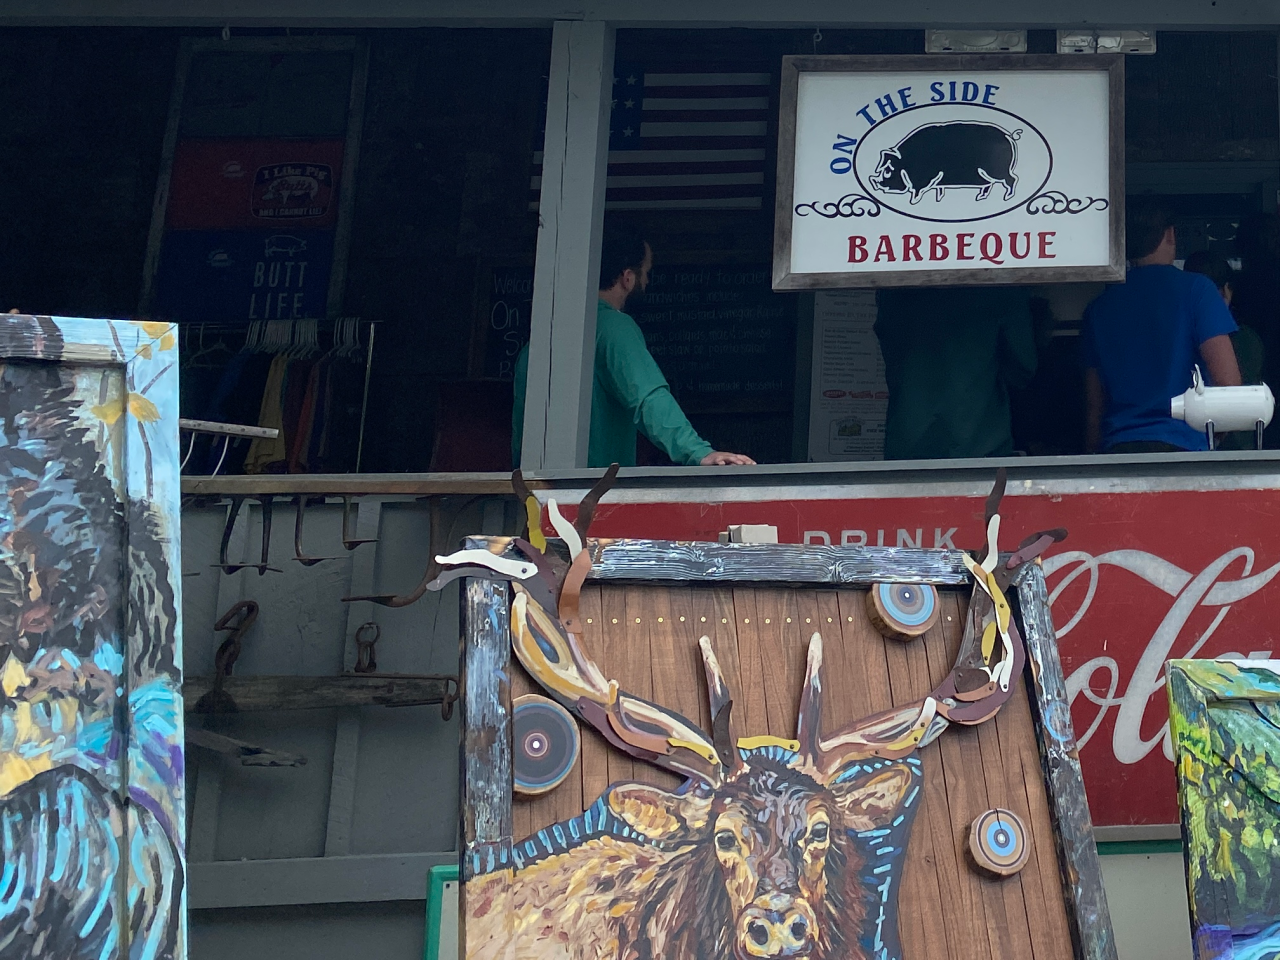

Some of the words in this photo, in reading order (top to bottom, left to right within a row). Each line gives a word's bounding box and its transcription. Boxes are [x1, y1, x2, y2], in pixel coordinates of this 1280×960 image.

[829, 133, 858, 175] ON
[856, 86, 917, 128] THE
[929, 81, 1000, 106] SIDE
[848, 231, 1057, 265] BARBEQUE
[253, 262, 308, 288] BUTT
[493, 271, 533, 295] Welco
[491, 300, 520, 330] On
